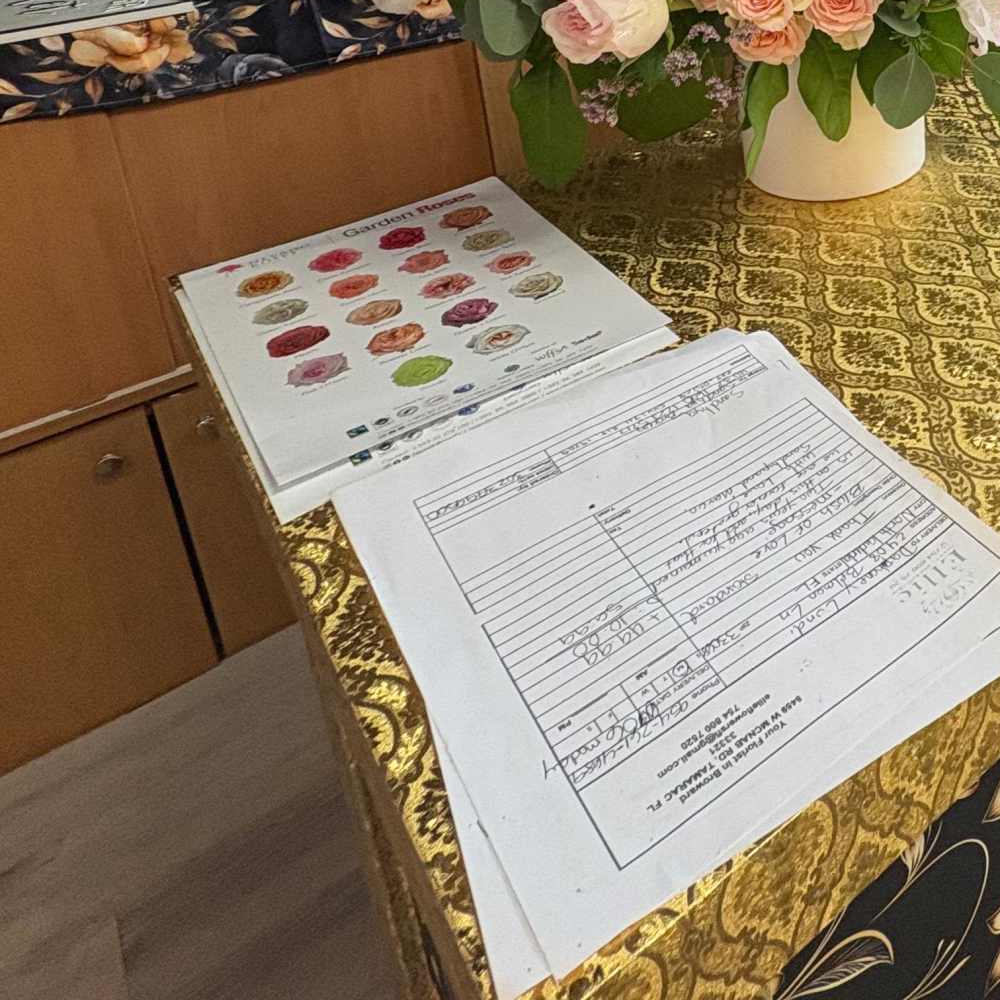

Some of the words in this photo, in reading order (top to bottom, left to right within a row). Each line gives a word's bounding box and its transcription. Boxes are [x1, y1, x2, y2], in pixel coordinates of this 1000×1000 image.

[342, 211, 414, 239] Garden
[417, 191, 476, 215] Roses
[721, 703, 740, 720] 754
[768, 710, 781, 722] W
[703, 716, 723, 733] 800
[762, 718, 786, 739] Your
[707, 730, 737, 755] 33321
[729, 736, 763, 765] Florist
[662, 759, 715, 803] TAMARAC
[677, 767, 722, 805] Broward
